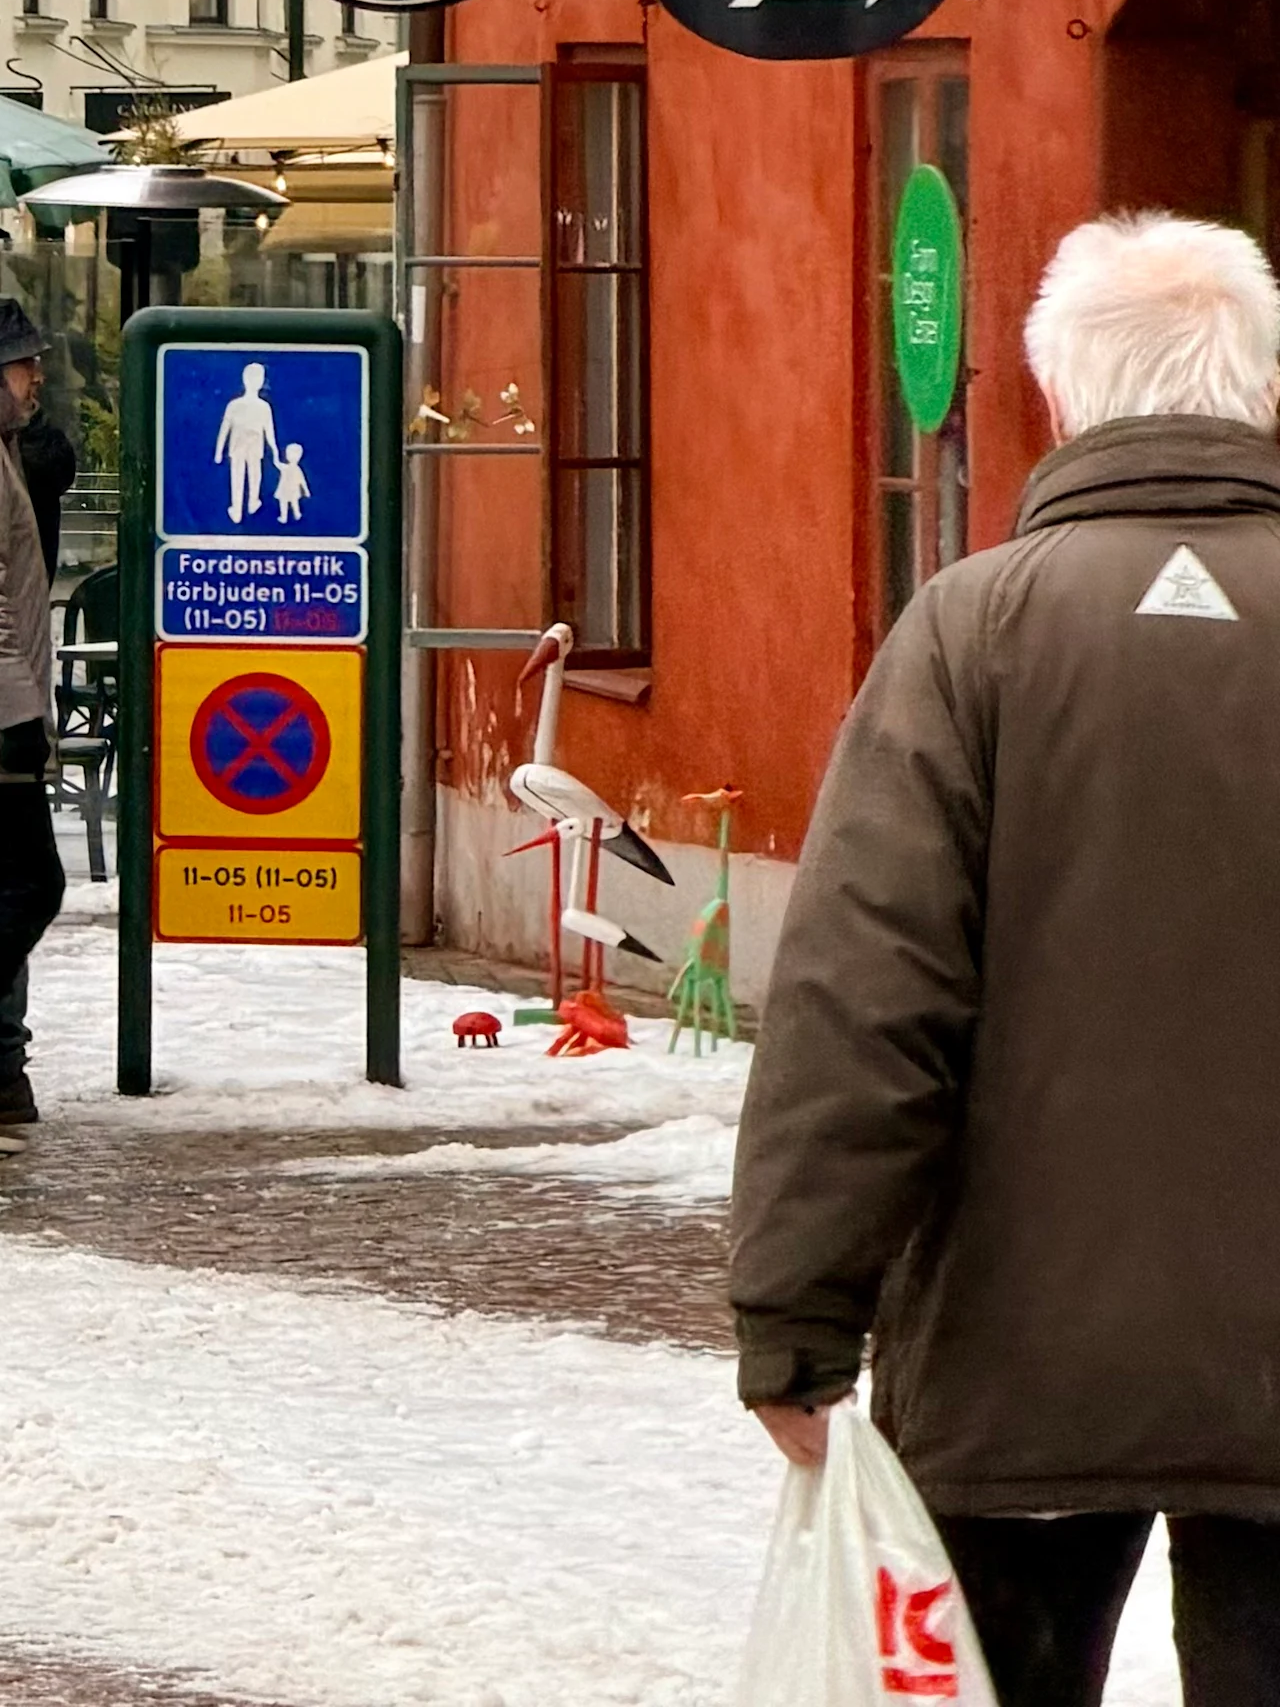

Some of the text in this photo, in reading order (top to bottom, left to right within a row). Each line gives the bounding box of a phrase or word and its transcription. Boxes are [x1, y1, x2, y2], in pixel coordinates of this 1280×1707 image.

[179, 554, 345, 576] Fordonstrafik
[166, 580, 359, 606] förbjuden 11-05
[184, 606, 267, 631] (11-05)
[183, 865, 337, 890] 11-05 (11-05)
[228, 903, 291, 924] 11-05
